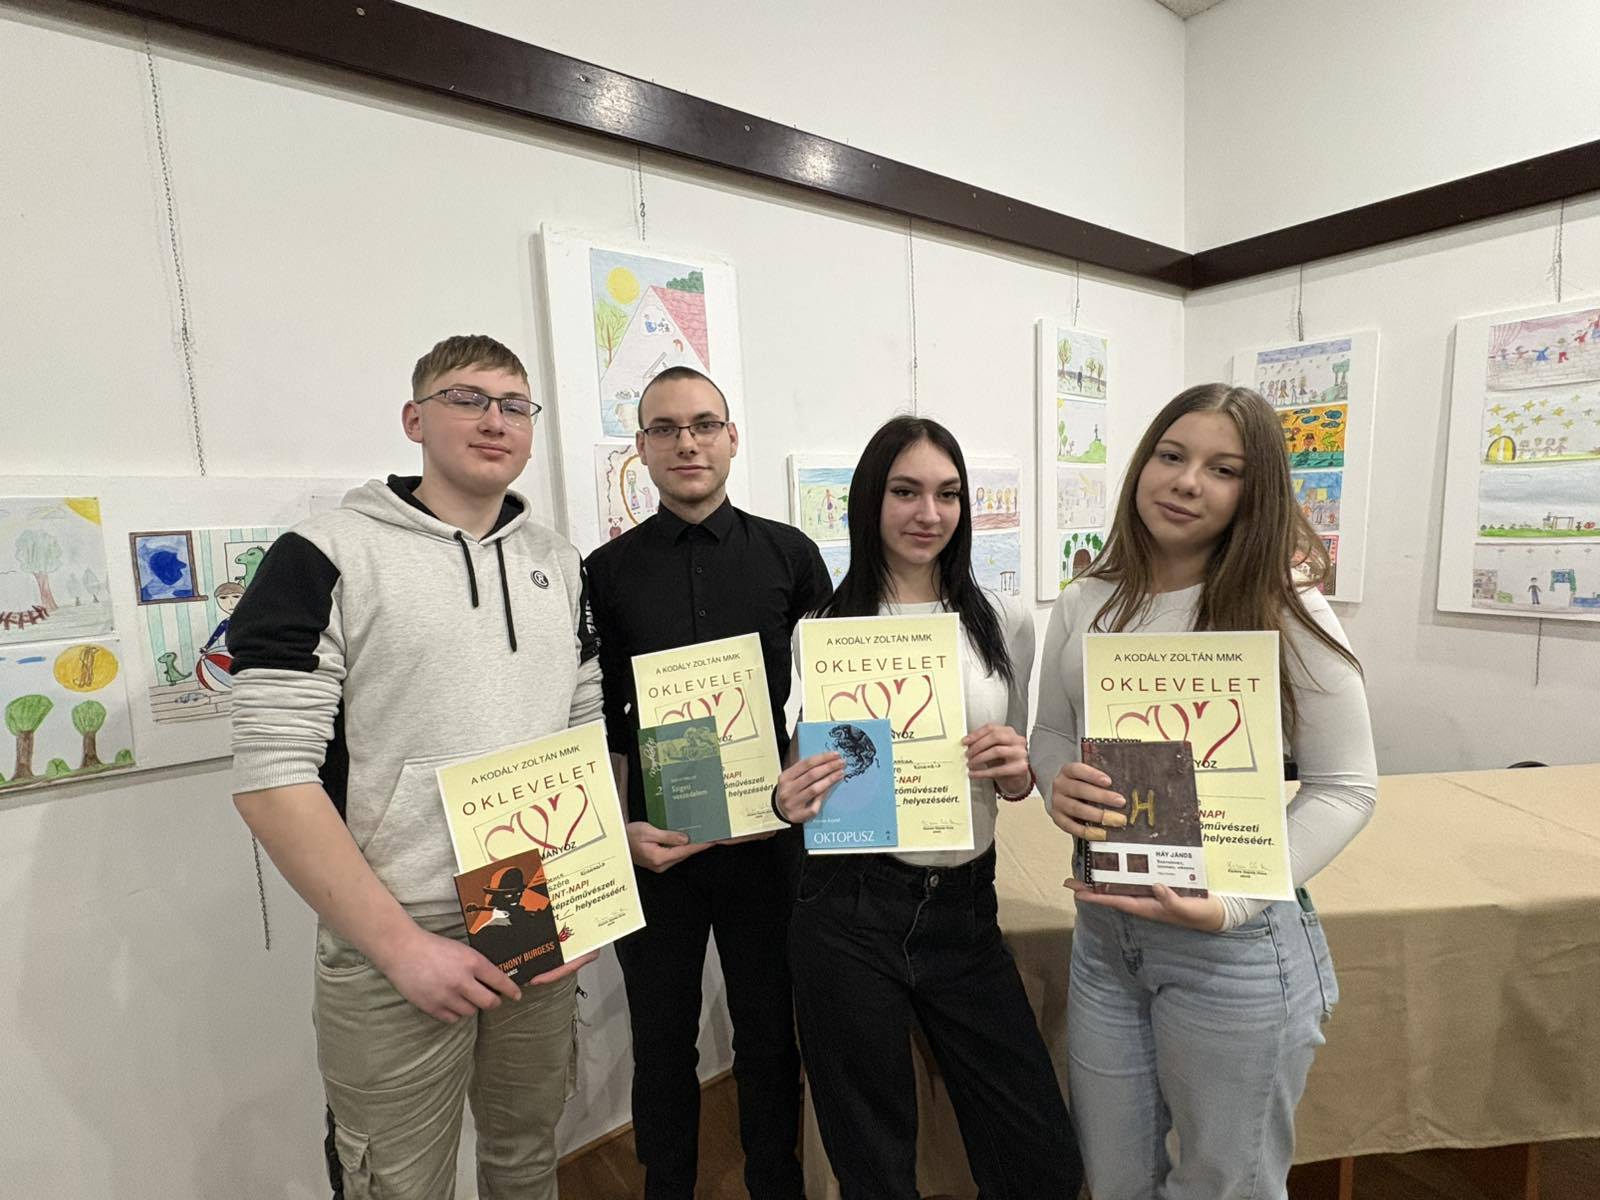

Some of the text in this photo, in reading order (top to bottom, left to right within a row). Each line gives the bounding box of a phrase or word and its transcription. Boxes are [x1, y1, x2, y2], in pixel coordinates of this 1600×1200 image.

[835, 635, 872, 645] KODÁLY
[873, 634, 909, 644] ZOLTÁN
[911, 634, 933, 642] MMK
[662, 661, 692, 673] KODÁLY
[693, 656, 721, 668] ZOLTÁN
[722, 653, 741, 662] MMK
[815, 655, 947, 674] OKLEVELET
[1114, 652, 1243, 662] A KODÁLY ZOLTÁN MMK
[648, 669, 754, 699] OKLEVELET
[1101, 677, 1260, 692] OKLEVELET
[471, 744, 581, 785] A KODÁLY ZOLTÁN MMK
[462, 760, 597, 816] OKLEVELET
[1129, 788, 1155, 827] H
[813, 830, 875, 844] OKTOPUSZ
[1170, 851, 1192, 859] JÁNOS
[523, 942, 556, 961] BURGESS
